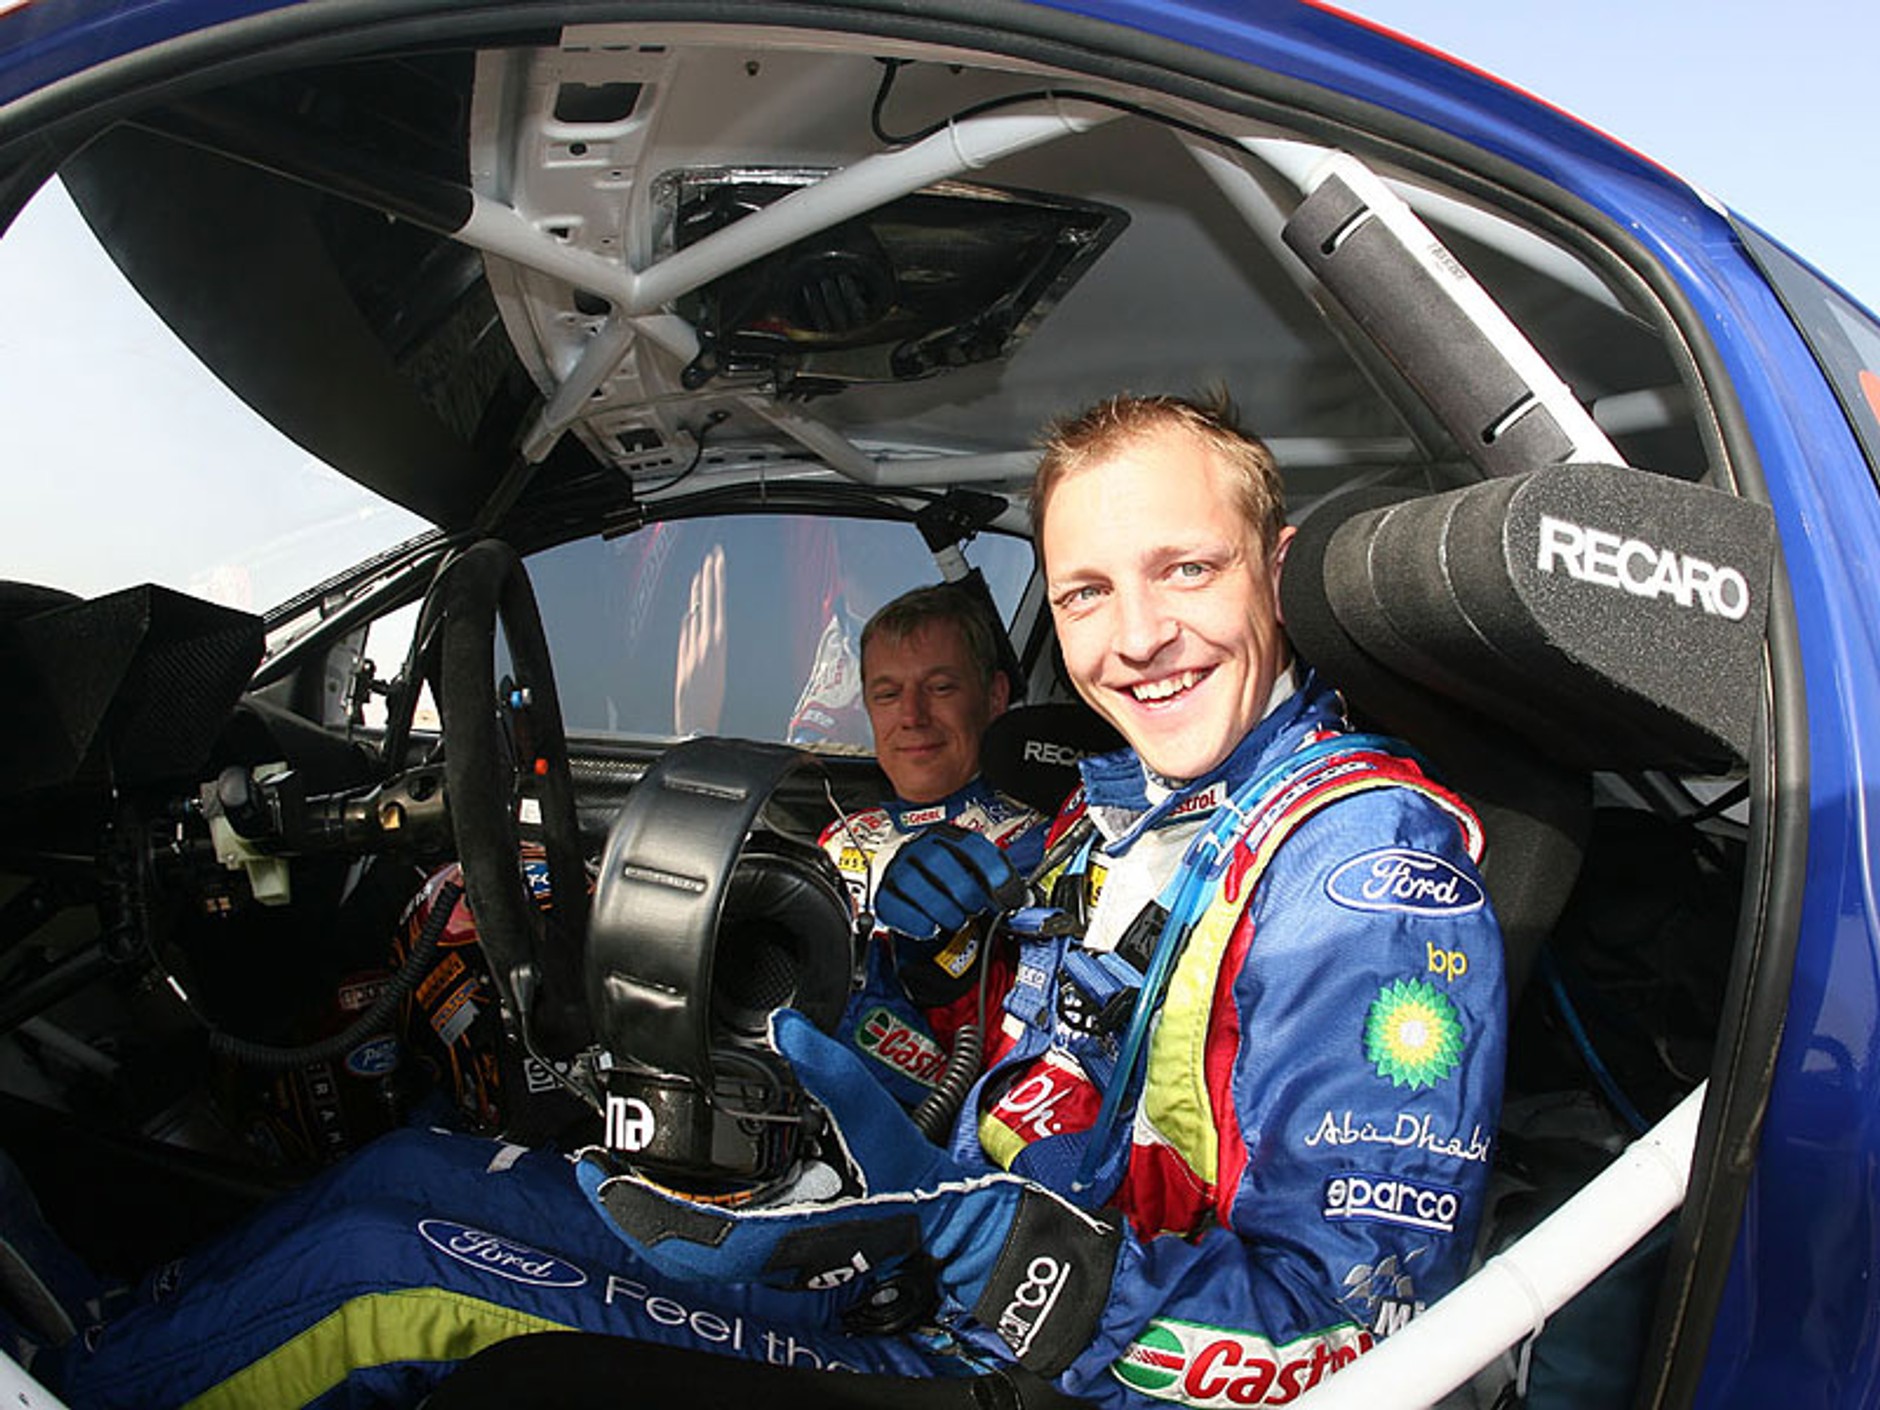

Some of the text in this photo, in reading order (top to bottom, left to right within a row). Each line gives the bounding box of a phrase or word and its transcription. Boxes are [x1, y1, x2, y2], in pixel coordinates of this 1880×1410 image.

[1537, 513, 1750, 622] RECARO
[1023, 740, 1092, 767] RECA
[1362, 854, 1460, 905] Ford
[1426, 941, 1467, 983] bp
[878, 1027, 949, 1084] Cast
[1304, 1110, 1492, 1162] Abu Dhabi
[1326, 1176, 1458, 1224] sparco
[450, 1230, 554, 1278] Ford
[606, 1275, 742, 1350] Feel
[997, 1256, 1064, 1352] arco
